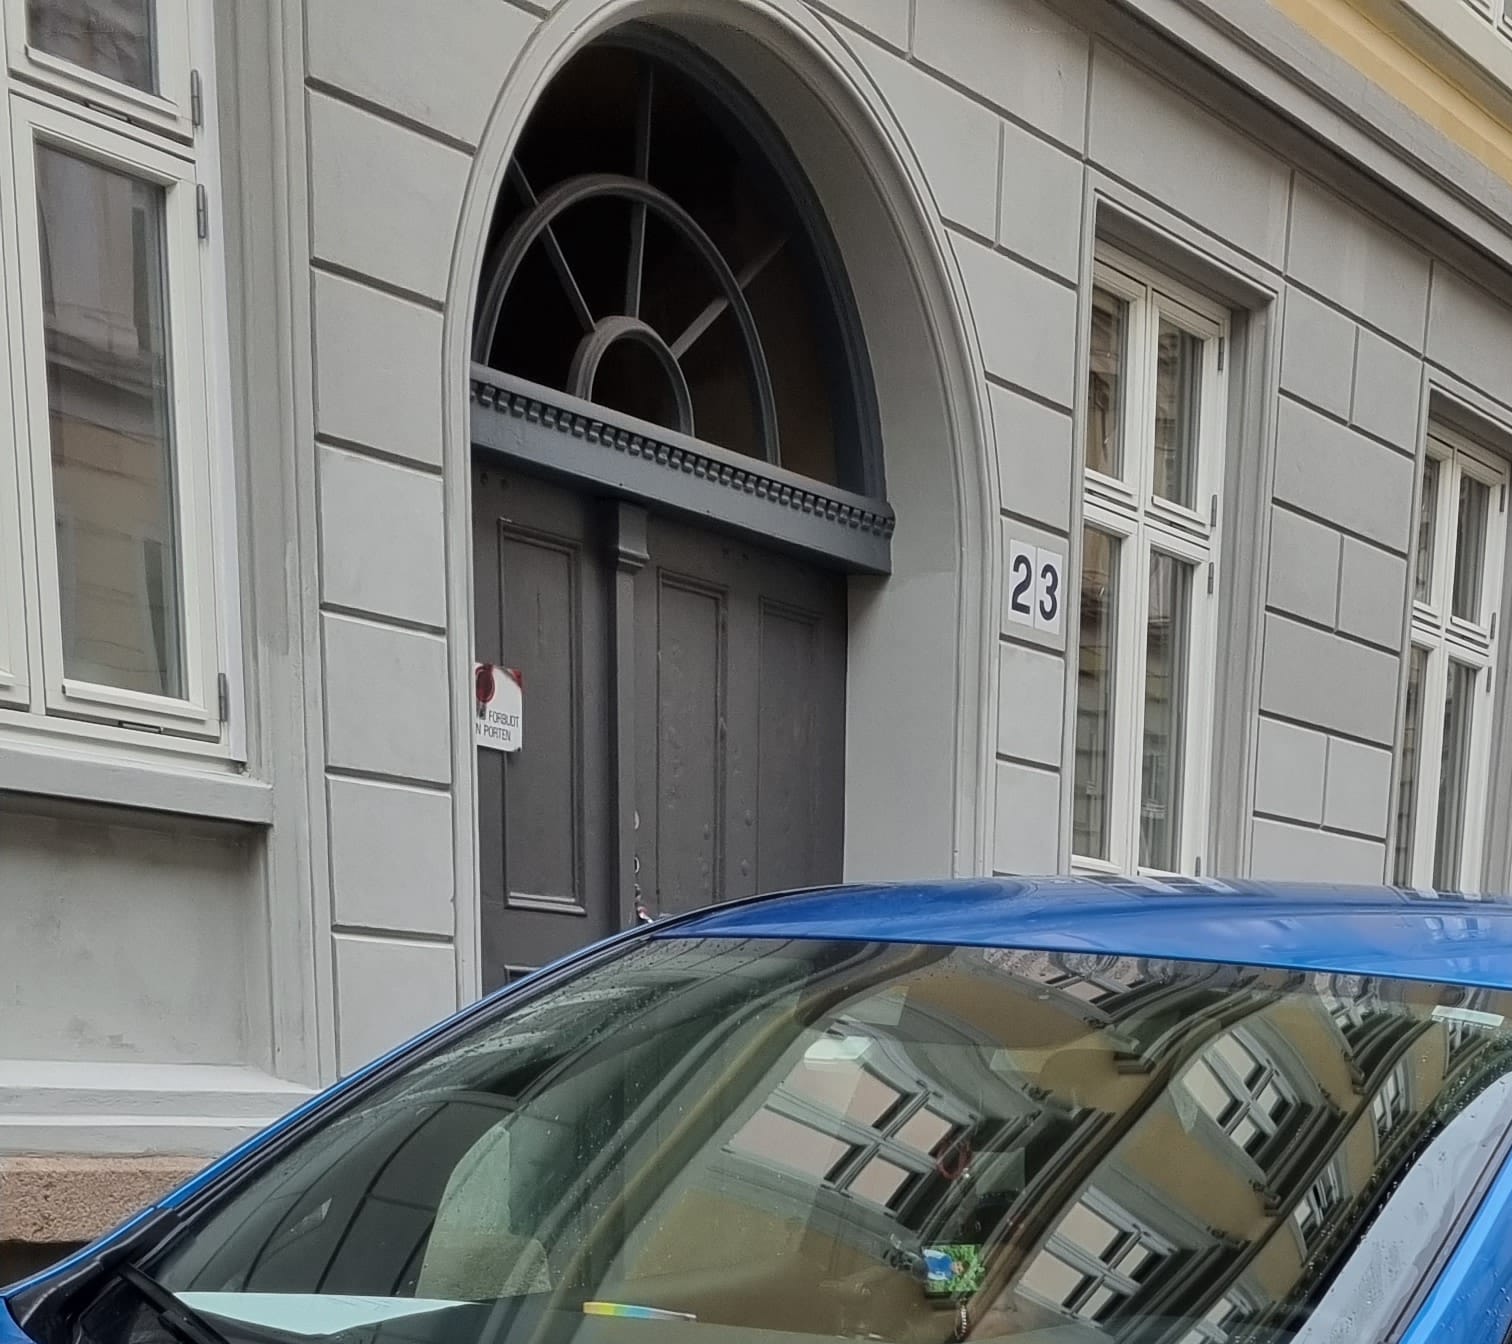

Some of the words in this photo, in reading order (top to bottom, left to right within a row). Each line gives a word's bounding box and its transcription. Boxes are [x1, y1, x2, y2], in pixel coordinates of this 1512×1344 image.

[1011, 554, 1058, 621] 23
[488, 710, 520, 728] FORBUDT
[483, 724, 512, 741] PORTEN
